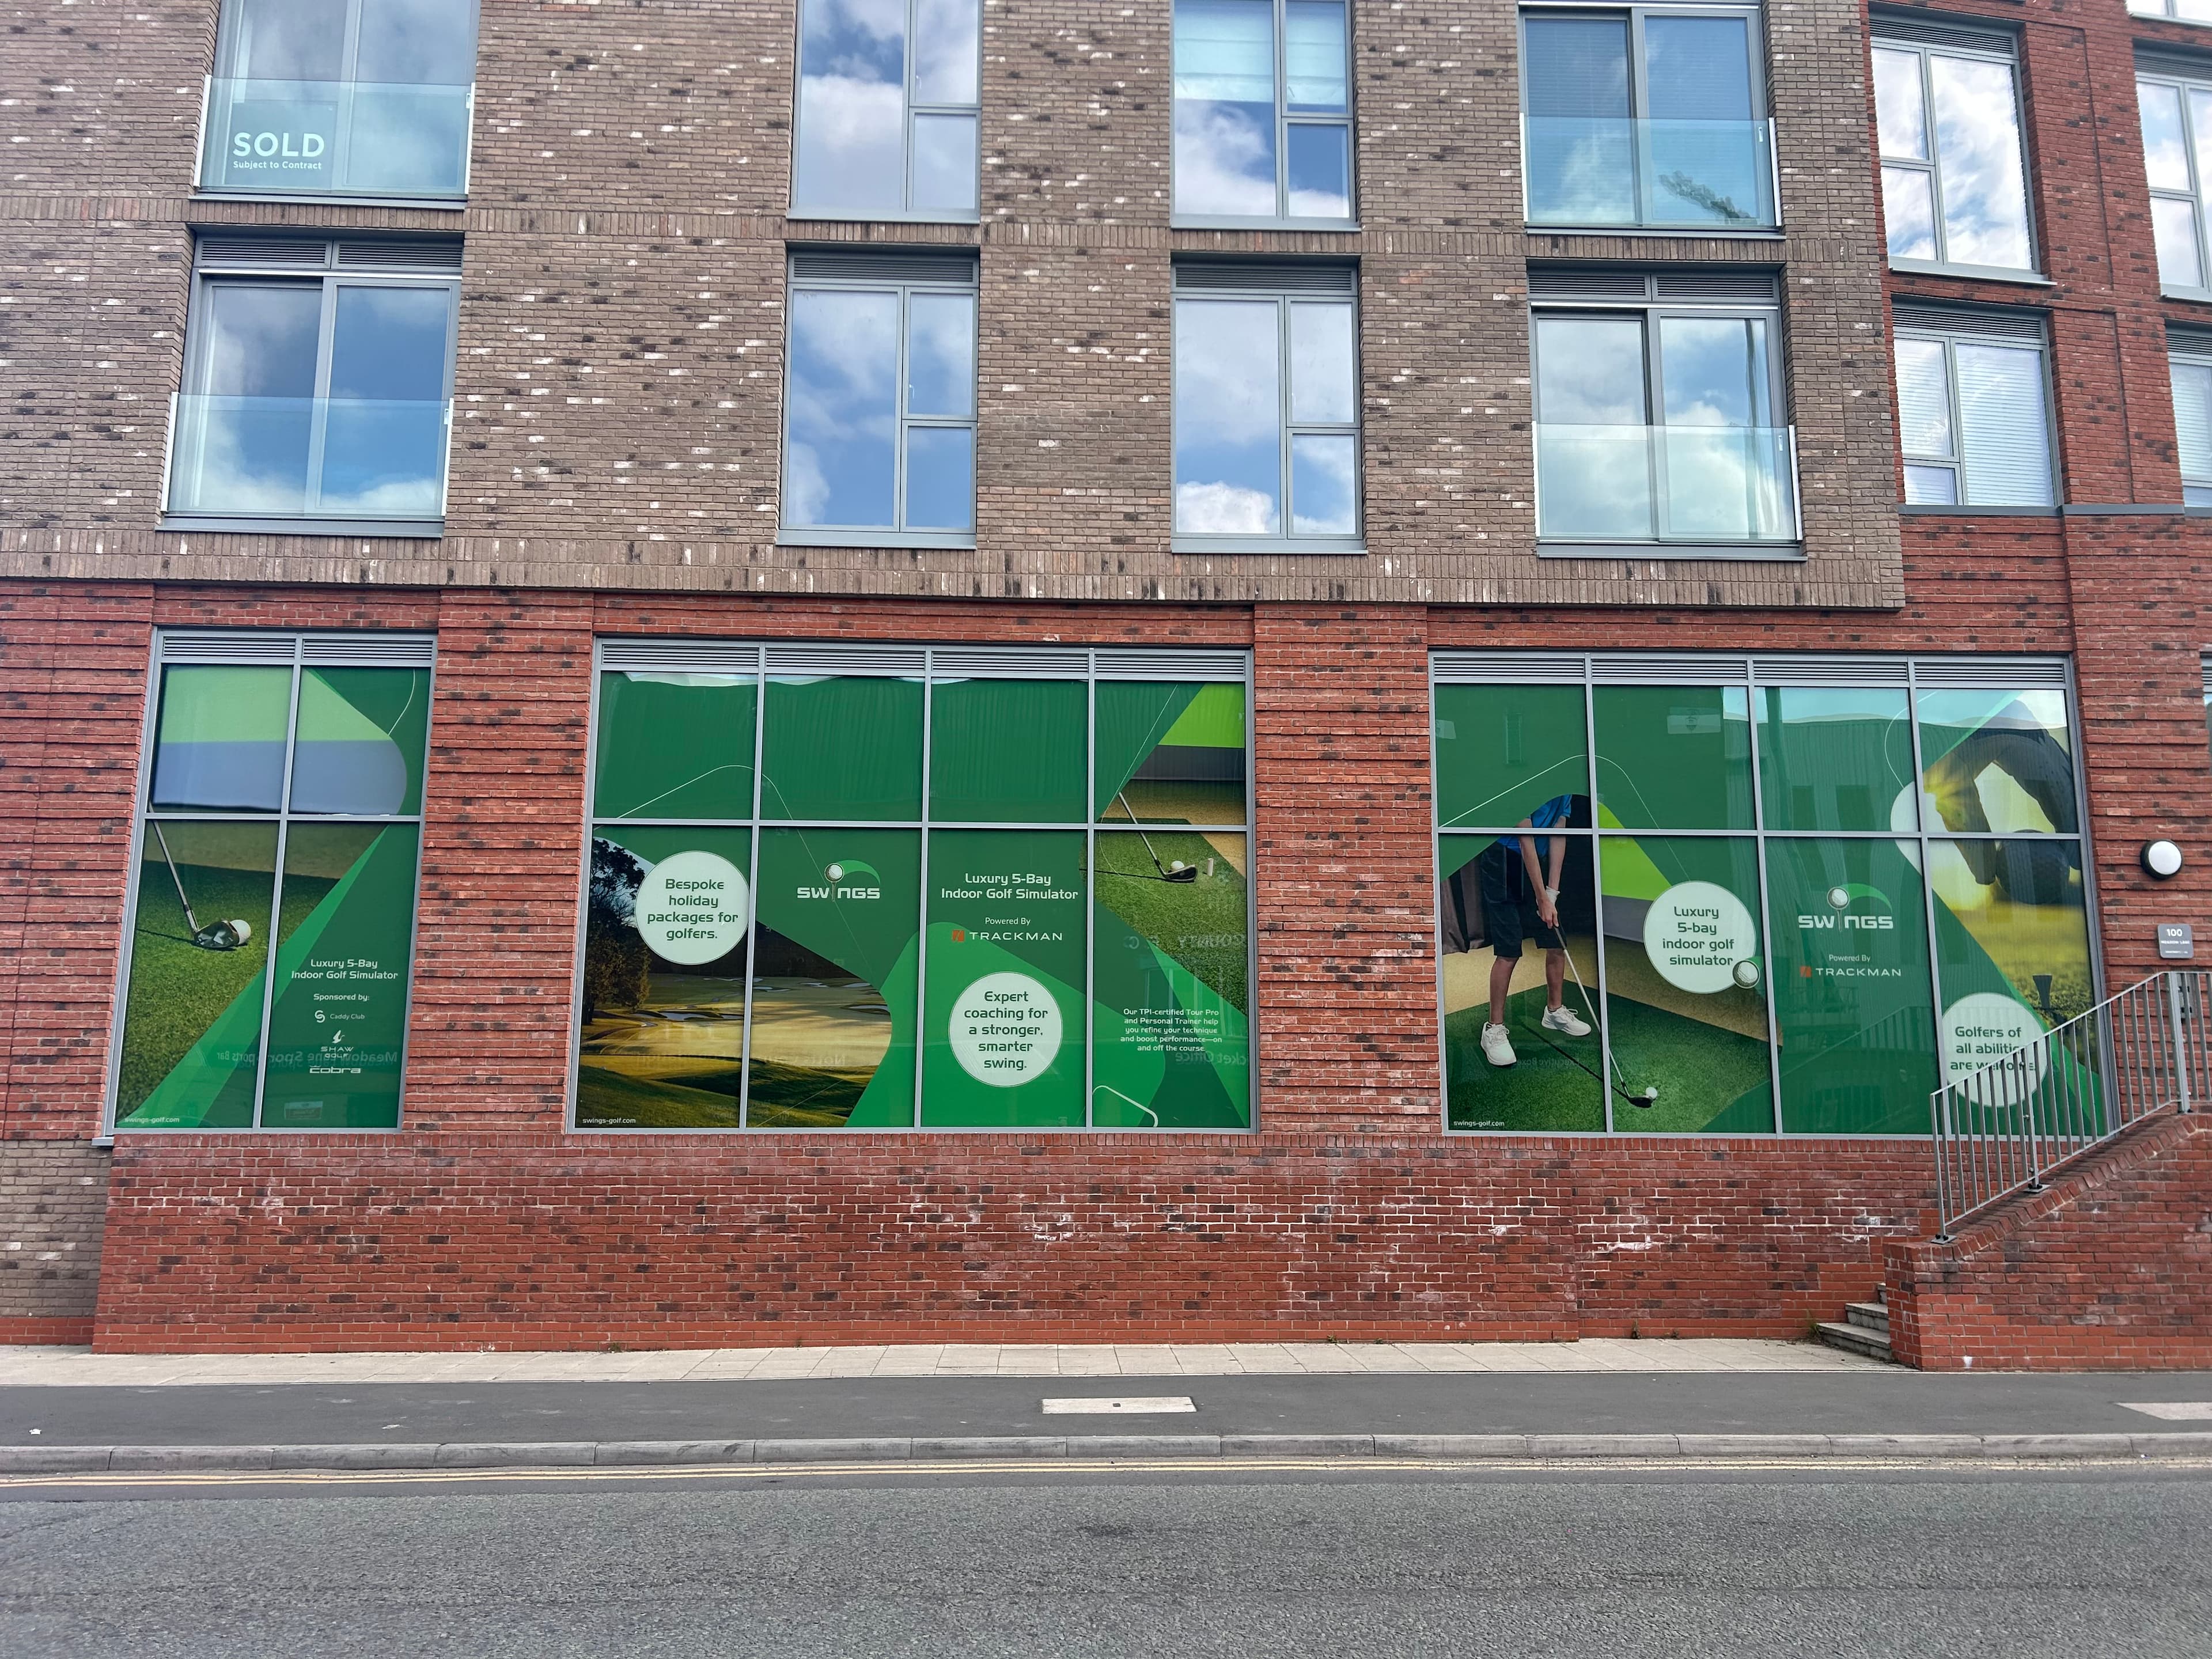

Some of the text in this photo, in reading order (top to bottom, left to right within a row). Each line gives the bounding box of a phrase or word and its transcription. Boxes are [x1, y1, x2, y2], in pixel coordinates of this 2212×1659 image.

[233, 132, 325, 157] SOLD
[233, 160, 322, 170] Subject to Contract
[665, 878, 724, 892] Bespoke
[965, 873, 1051, 887] Luxury 5-Bay
[941, 888, 1078, 899] Indoor Golf Simulator
[669, 895, 718, 908] holiday
[647, 911, 738, 925] packages for
[1674, 906, 1719, 919] Luxury
[1021, 917, 1031, 926] By
[1677, 922, 1717, 935] 5-bay
[2166, 929, 2183, 937] 100
[666, 928, 718, 941] golfers.
[969, 932, 1062, 941] TRACKMAN
[1662, 938, 1734, 952] indoor golf
[310, 959, 378, 969] Luxury 5-Bay
[1669, 955, 1733, 965] simulator
[1828, 954, 1872, 963] Powered By
[291, 971, 398, 979] Indoor Golf Simulator
[1815, 968, 1902, 976] TRACKMAN
[313, 993, 369, 1002] Sponsored by:
[984, 991, 1029, 1005] Expert
[964, 1007, 1048, 1021] coaching for
[1204, 1017, 1219, 1026] help
[968, 1027, 977, 1035] a
[1126, 1027, 1139, 1035] you
[1955, 1027, 2021, 1037] Golfers of
[978, 1041, 1033, 1052] smarter
[1956, 1043, 2020, 1054] all abiliti
[984, 1057, 1027, 1071] swing.
